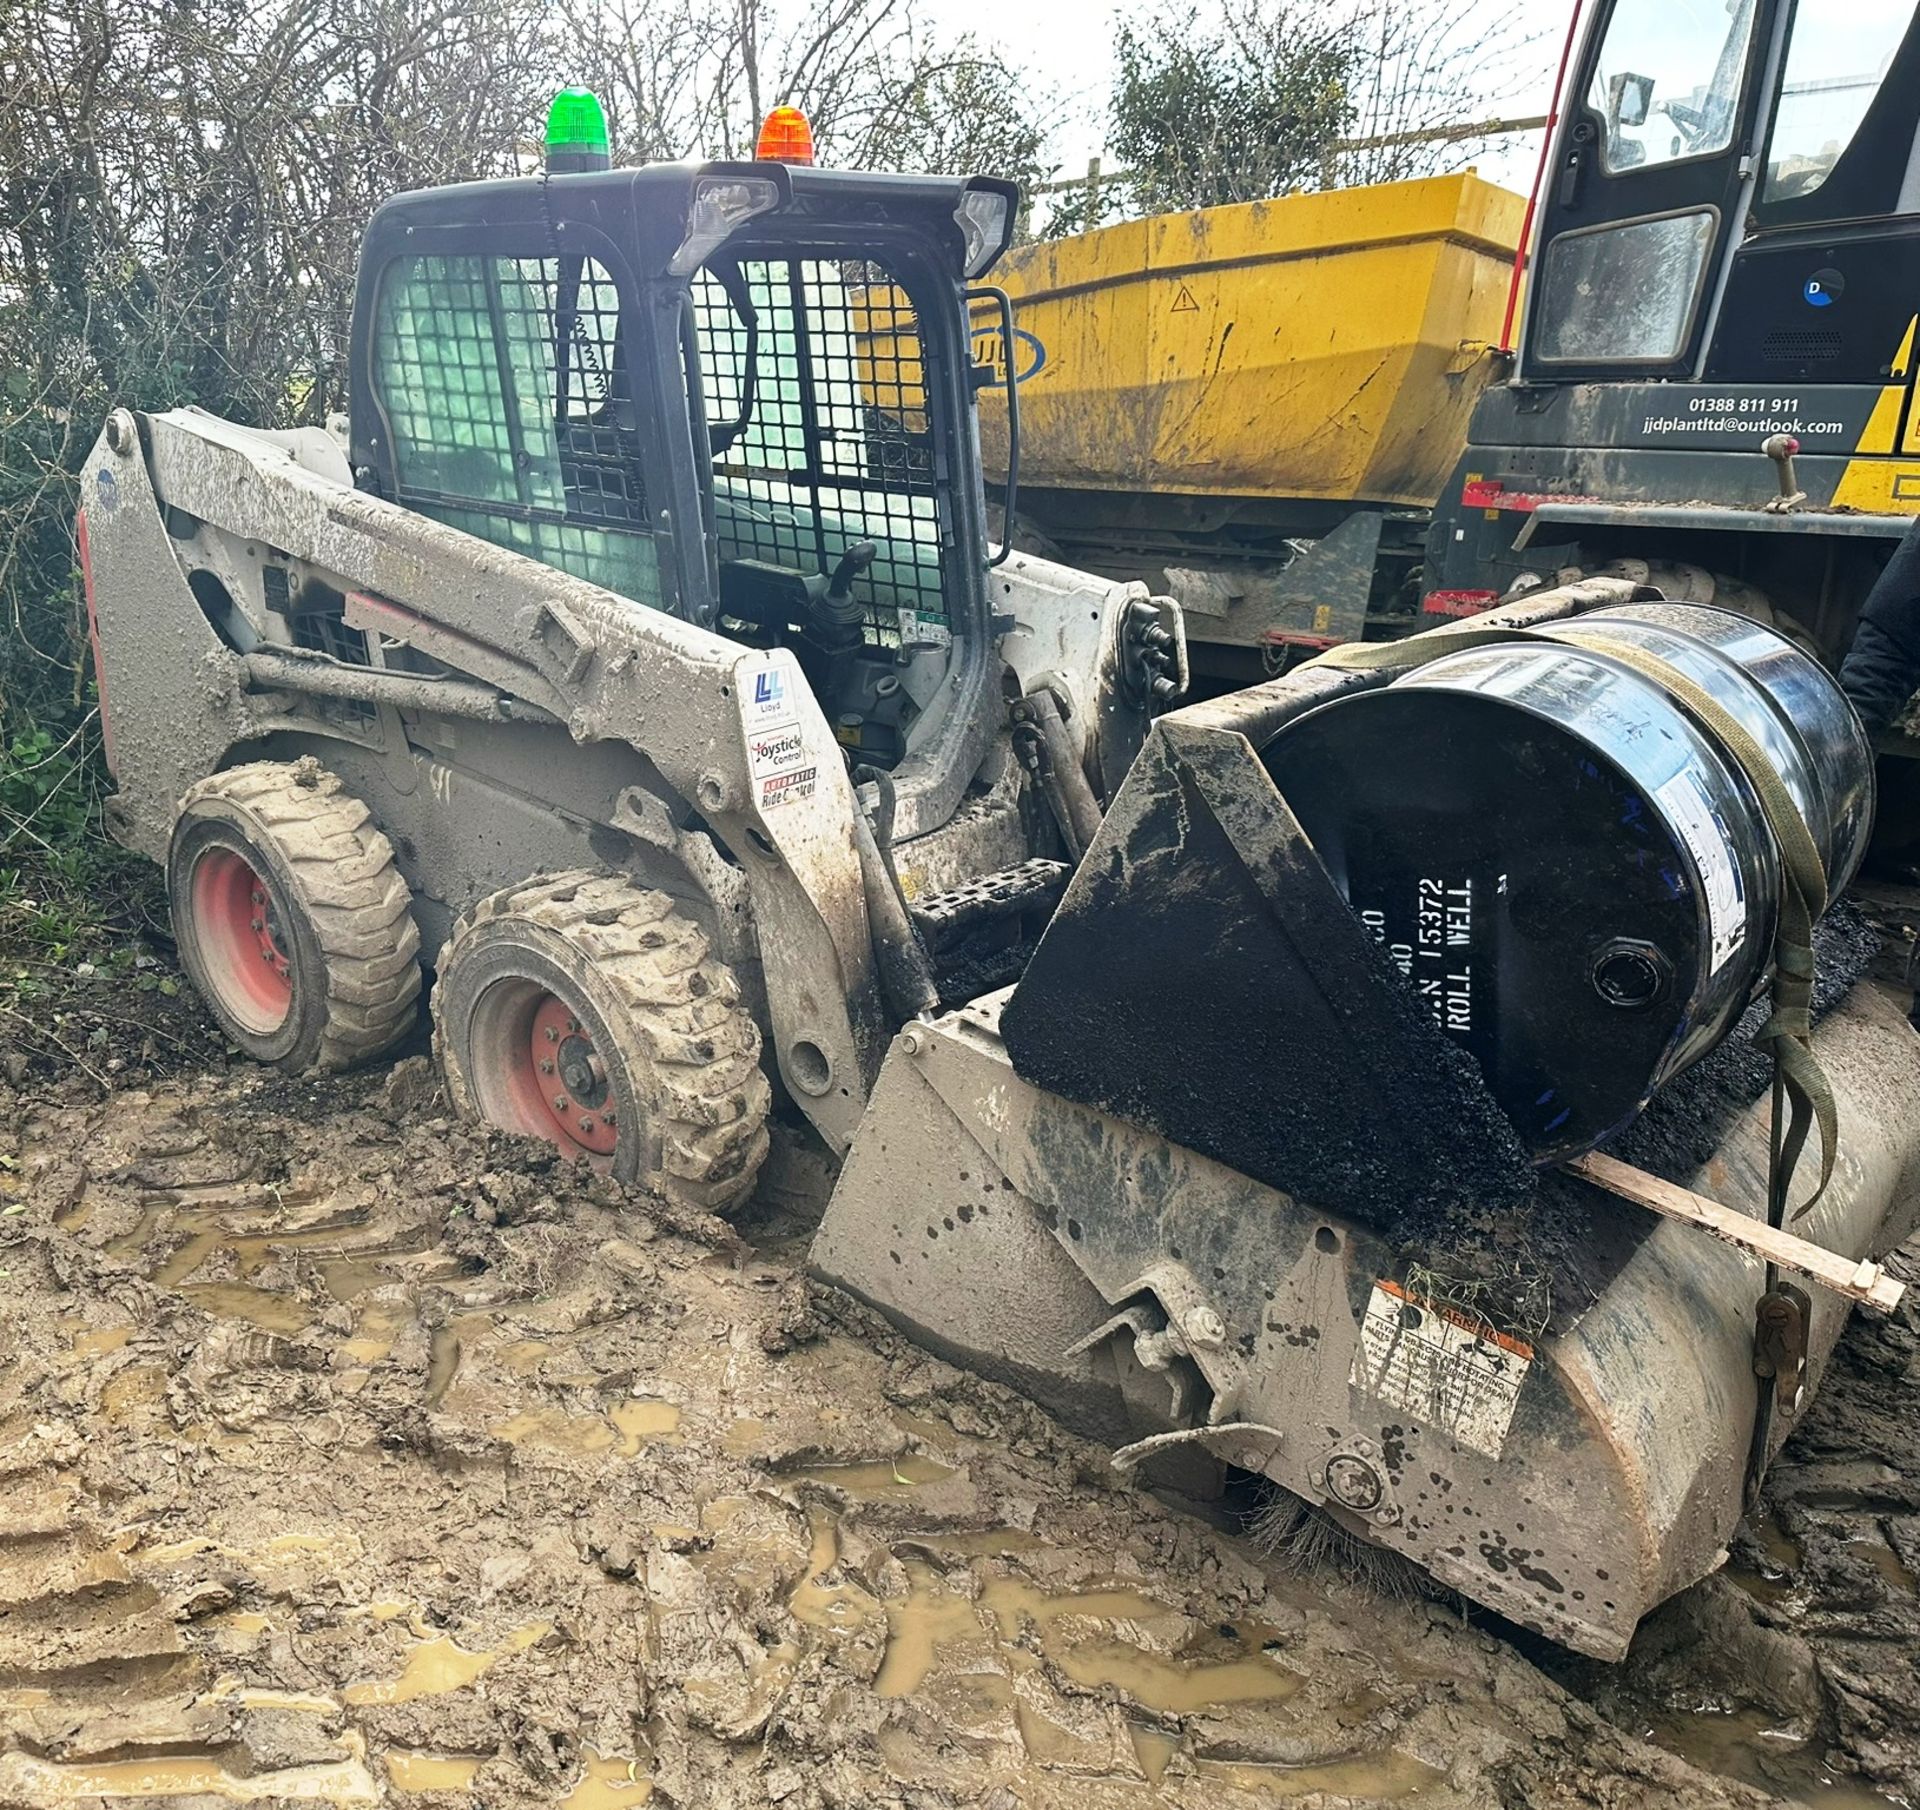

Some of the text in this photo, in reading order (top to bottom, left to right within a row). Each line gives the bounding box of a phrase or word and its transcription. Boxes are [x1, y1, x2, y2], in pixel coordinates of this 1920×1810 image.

[1689, 398, 1799, 413] 01388 811 911
[1642, 417, 1843, 434] jjdplantltd@outlook.com
[761, 702, 781, 713] Lloyd
[773, 750, 801, 765] Control
[764, 768, 816, 793] AUTOMATIC
[762, 780, 815, 808] Ride Ctrol
[1419, 878, 1443, 957] 15372
[1447, 879, 1472, 1031] ROLL WELL
[1403, 1335, 1442, 1358] OBECTS
